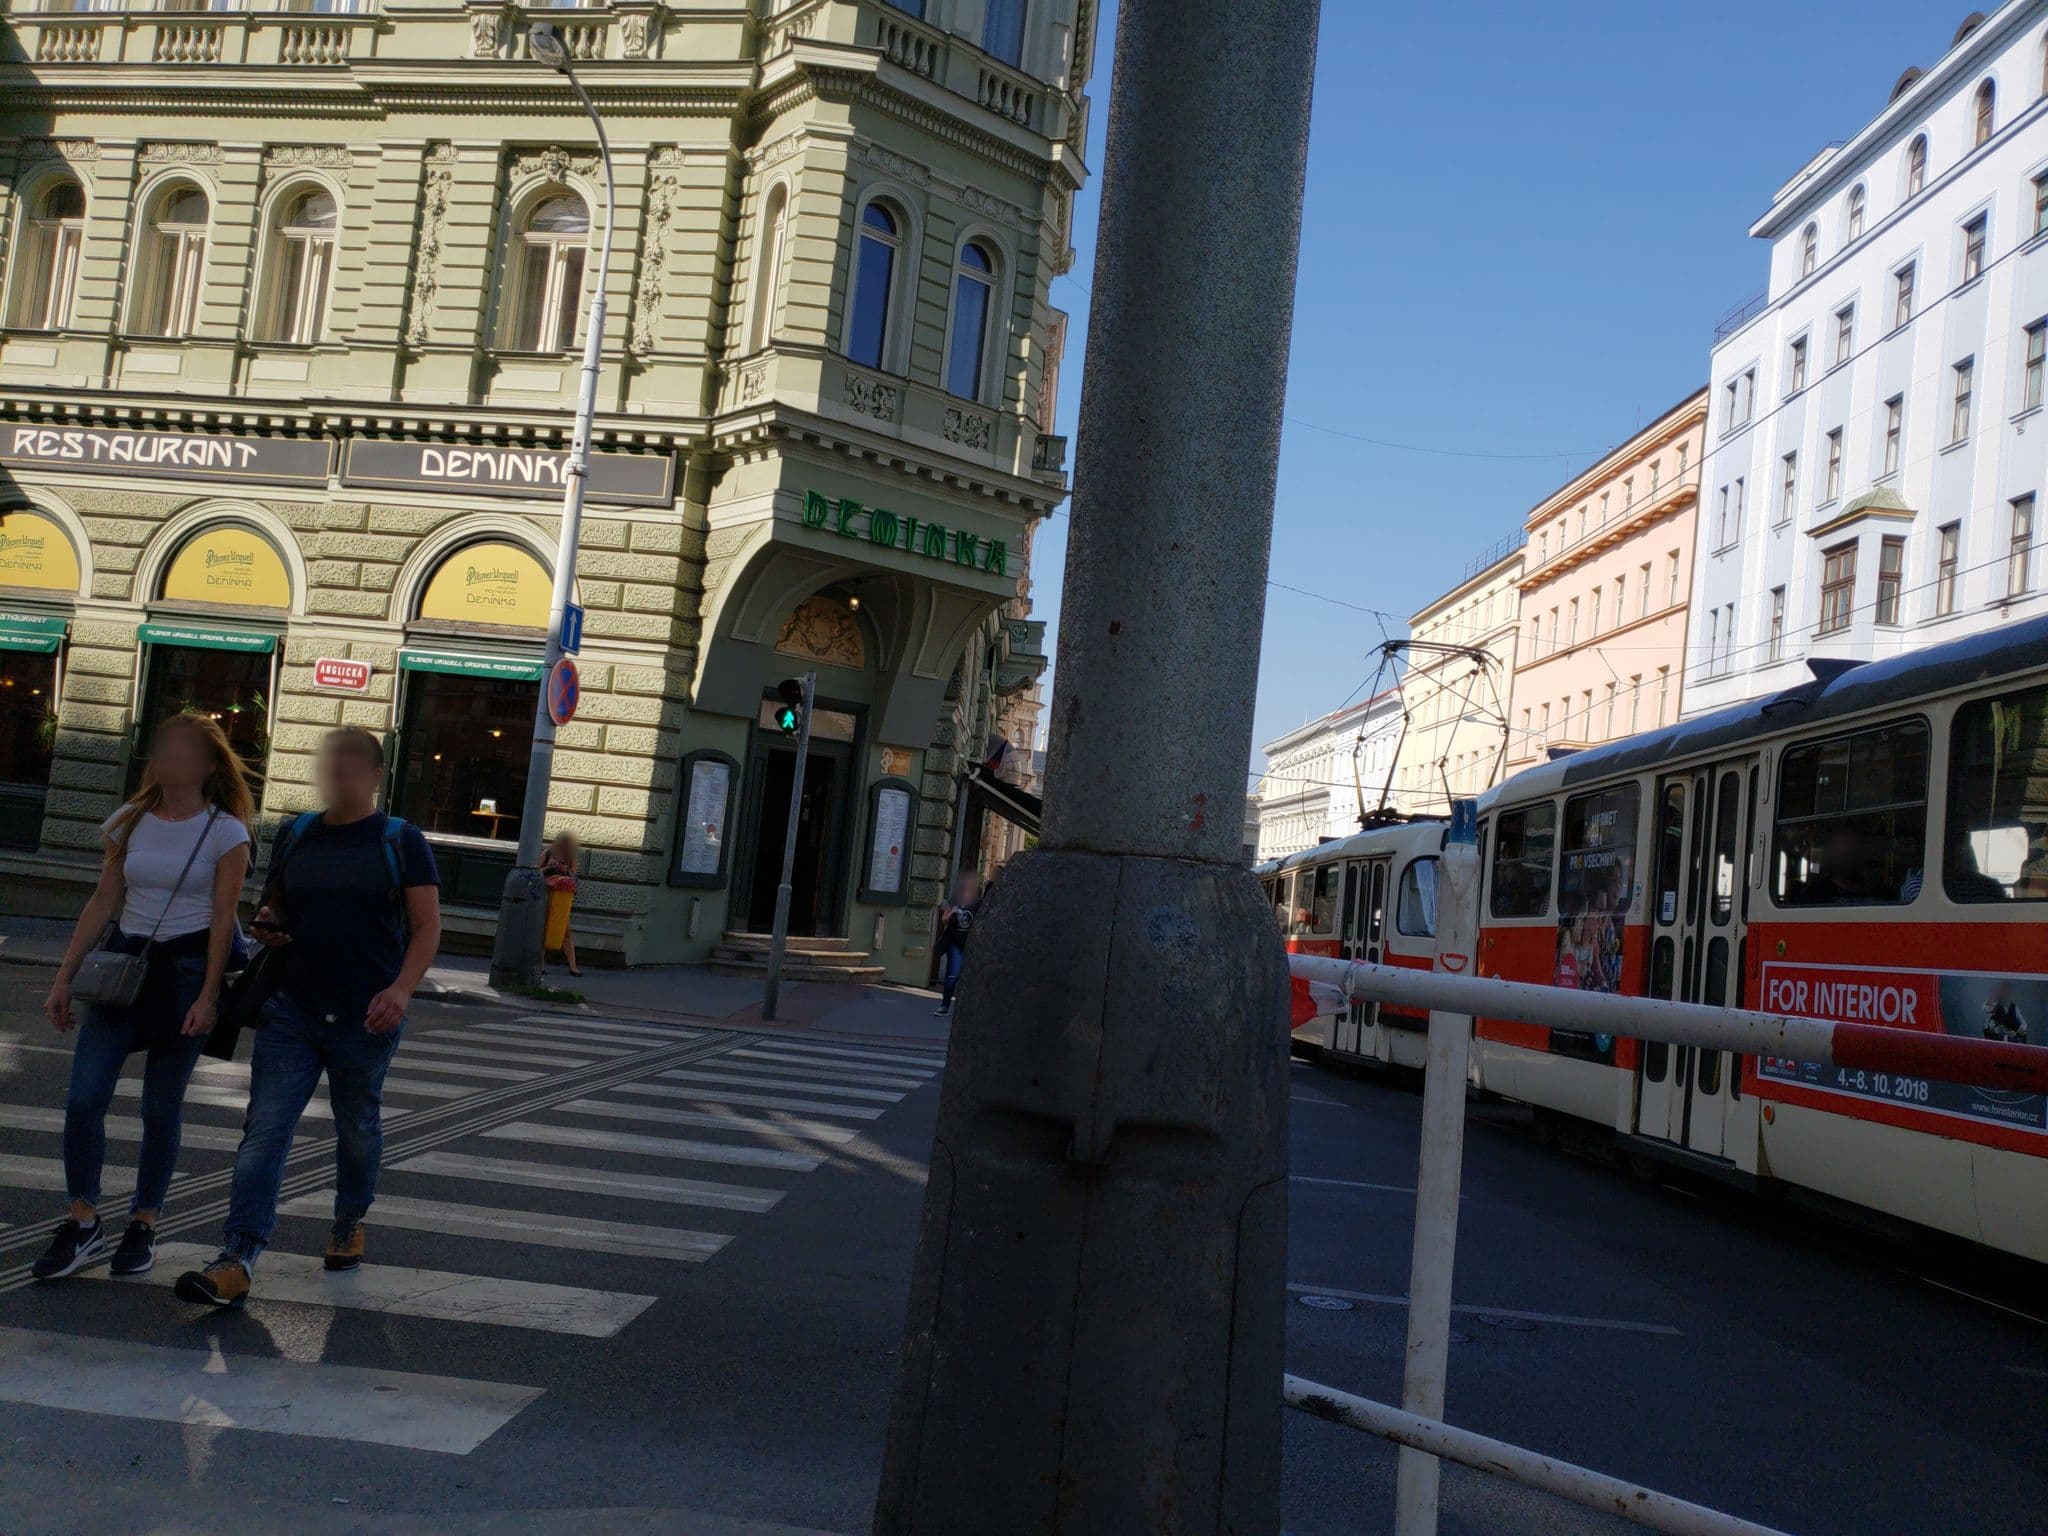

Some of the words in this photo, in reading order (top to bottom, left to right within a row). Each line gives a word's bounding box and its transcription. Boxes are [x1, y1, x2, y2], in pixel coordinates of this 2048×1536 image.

[13, 429, 257, 468] RESTAURANT
[803, 488, 1008, 577] DEMINKA
[466, 566, 494, 586] Pilsner
[493, 568, 519, 583] Urquell
[1768, 978, 1809, 1013] FOR
[1813, 981, 1918, 1025] INTERIOR
[1873, 1073, 1891, 1095] 10.
[1895, 1077, 1929, 1101] 2018
